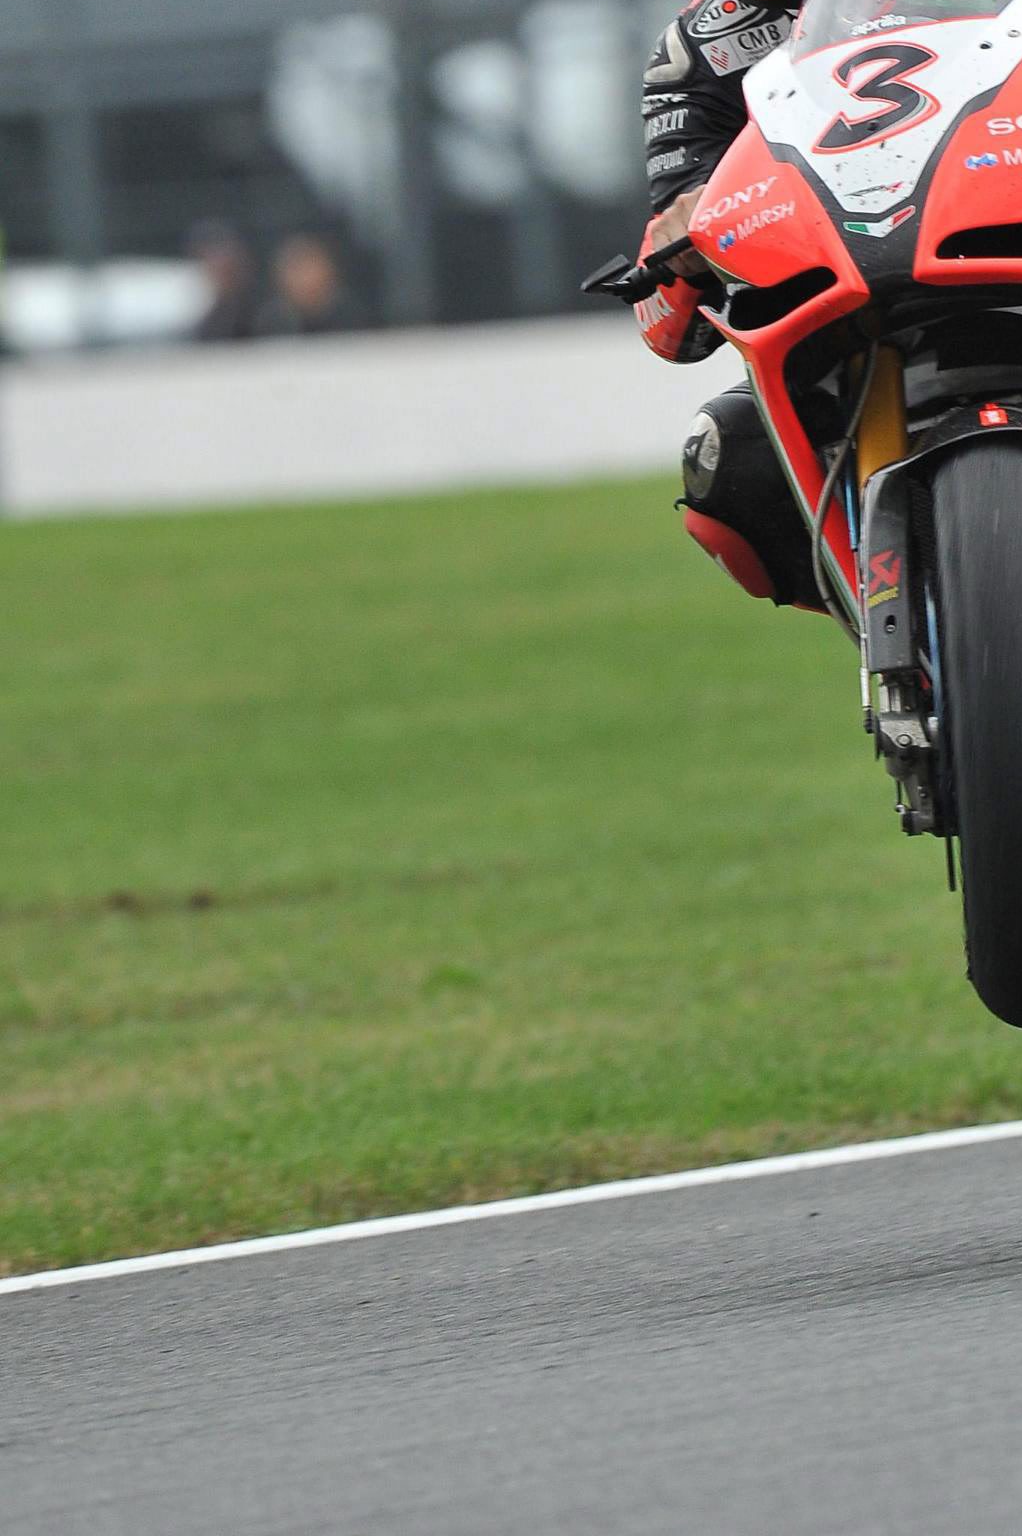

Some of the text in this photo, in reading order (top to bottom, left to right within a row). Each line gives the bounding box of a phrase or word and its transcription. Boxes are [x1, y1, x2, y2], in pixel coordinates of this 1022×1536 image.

[737, 24, 782, 51] CMB
[811, 40, 941, 155] 3
[697, 175, 778, 232] SONY
[736, 200, 796, 240] MARSH
